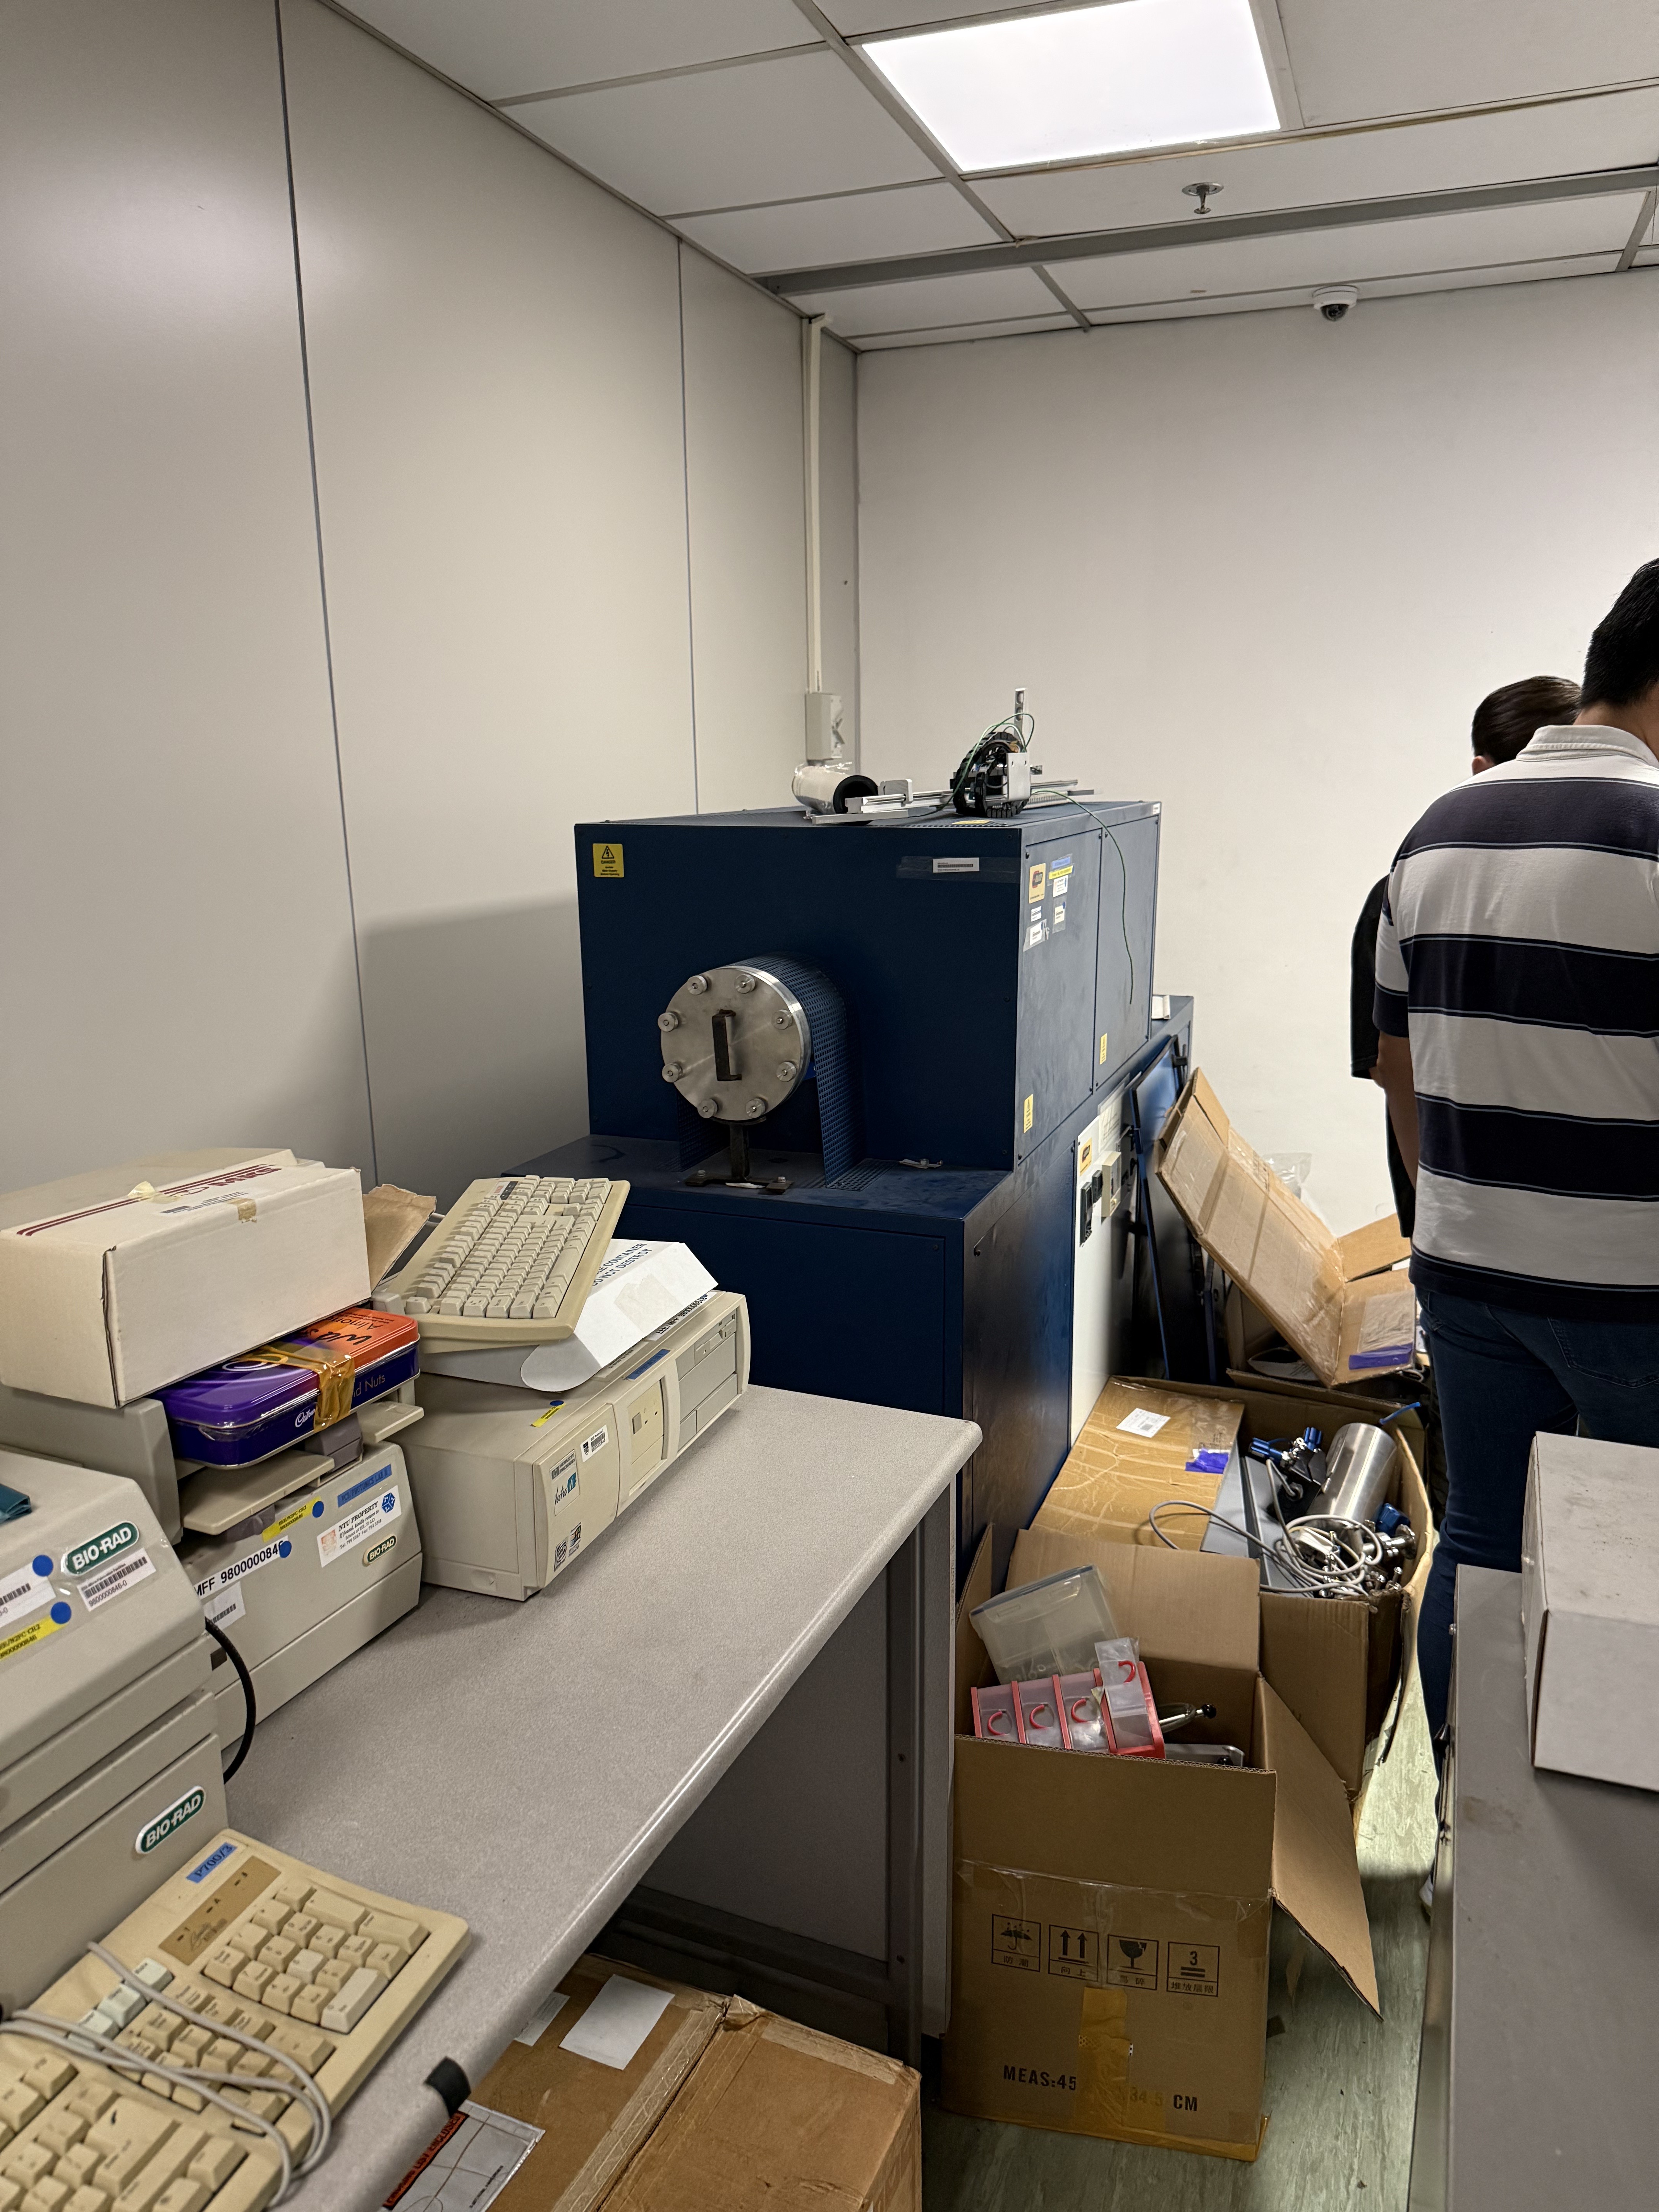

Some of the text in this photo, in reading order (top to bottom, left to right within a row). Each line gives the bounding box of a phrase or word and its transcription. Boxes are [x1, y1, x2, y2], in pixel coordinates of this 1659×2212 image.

[599, 1268, 620, 1278] NOT
[615, 1249, 653, 1268] DESTROY
[603, 1243, 647, 1267] CONTAINER
[365, 1375, 386, 1391] Nuts
[339, 1501, 378, 1532] NTU PROPERTY
[72, 1527, 132, 1570] BIO-RAD
[369, 1538, 395, 1561] BIO-RAD
[220, 1540, 283, 1584] 980000084
[146, 1795, 201, 1849] BIO-RAD
[1190, 1951, 1198, 1966] 3
[1173, 2094, 1198, 2112] CM
